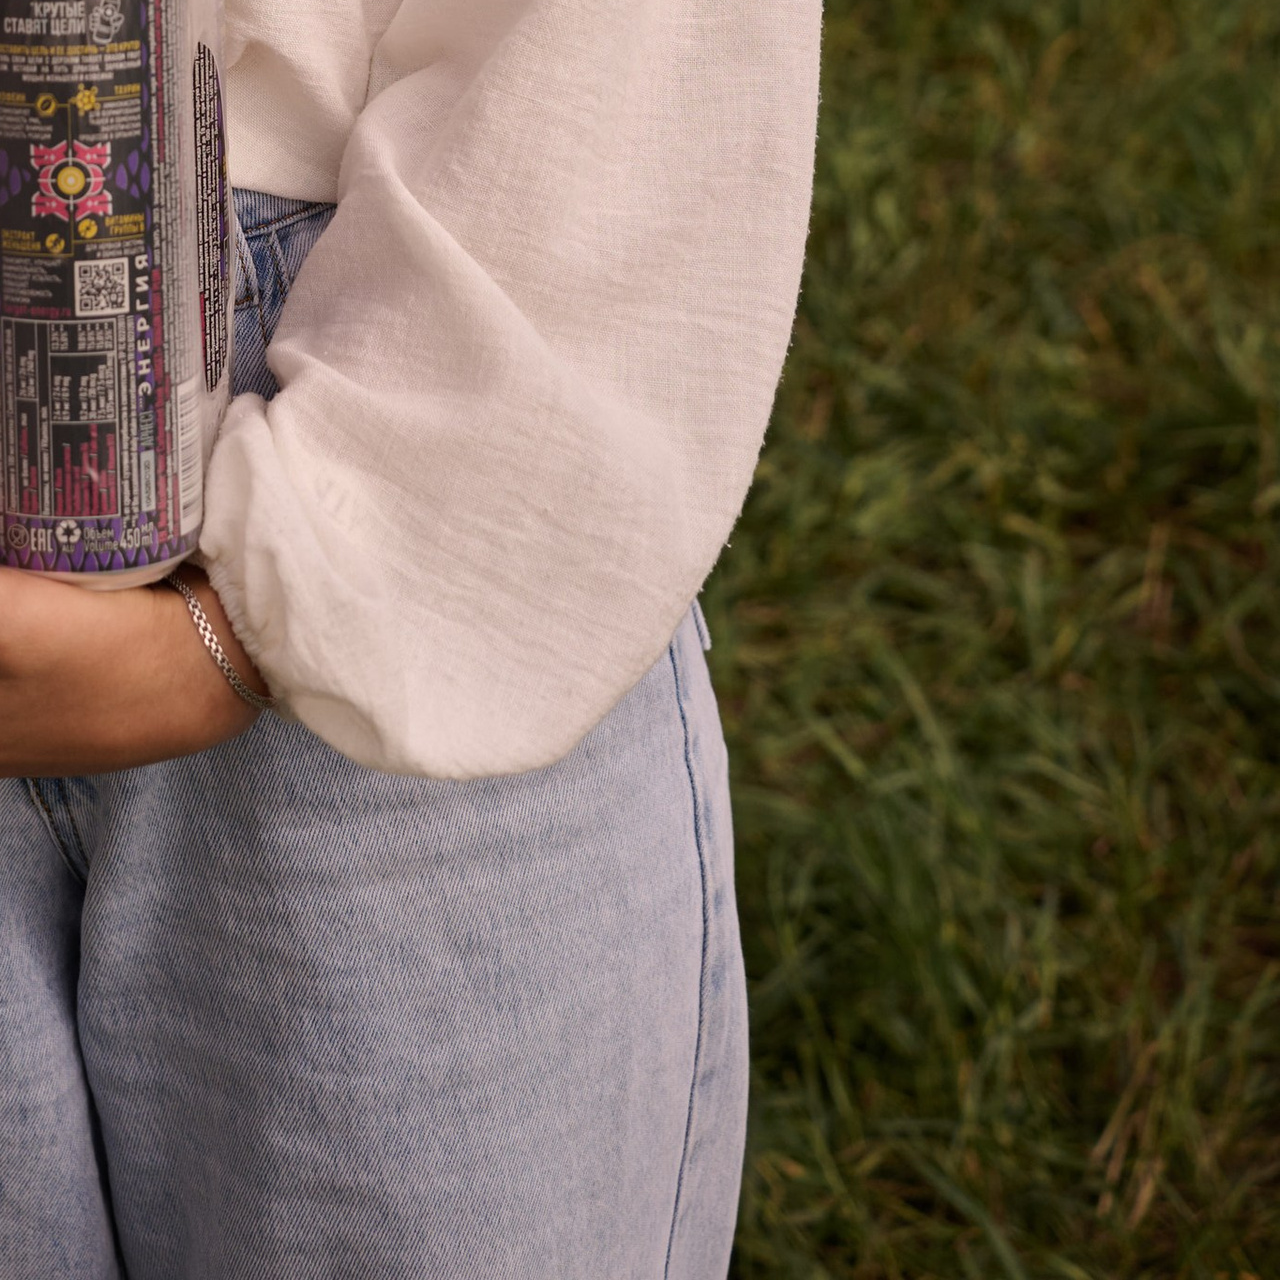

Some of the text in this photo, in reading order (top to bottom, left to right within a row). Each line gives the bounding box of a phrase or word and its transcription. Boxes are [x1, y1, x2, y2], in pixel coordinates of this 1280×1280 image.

[4, 18, 86, 36] СТАВЯТ ЦЕЛИ
[84, 527, 114, 539] Объем
[120, 528, 140, 549] 450
[84, 540, 118, 551] Volume
